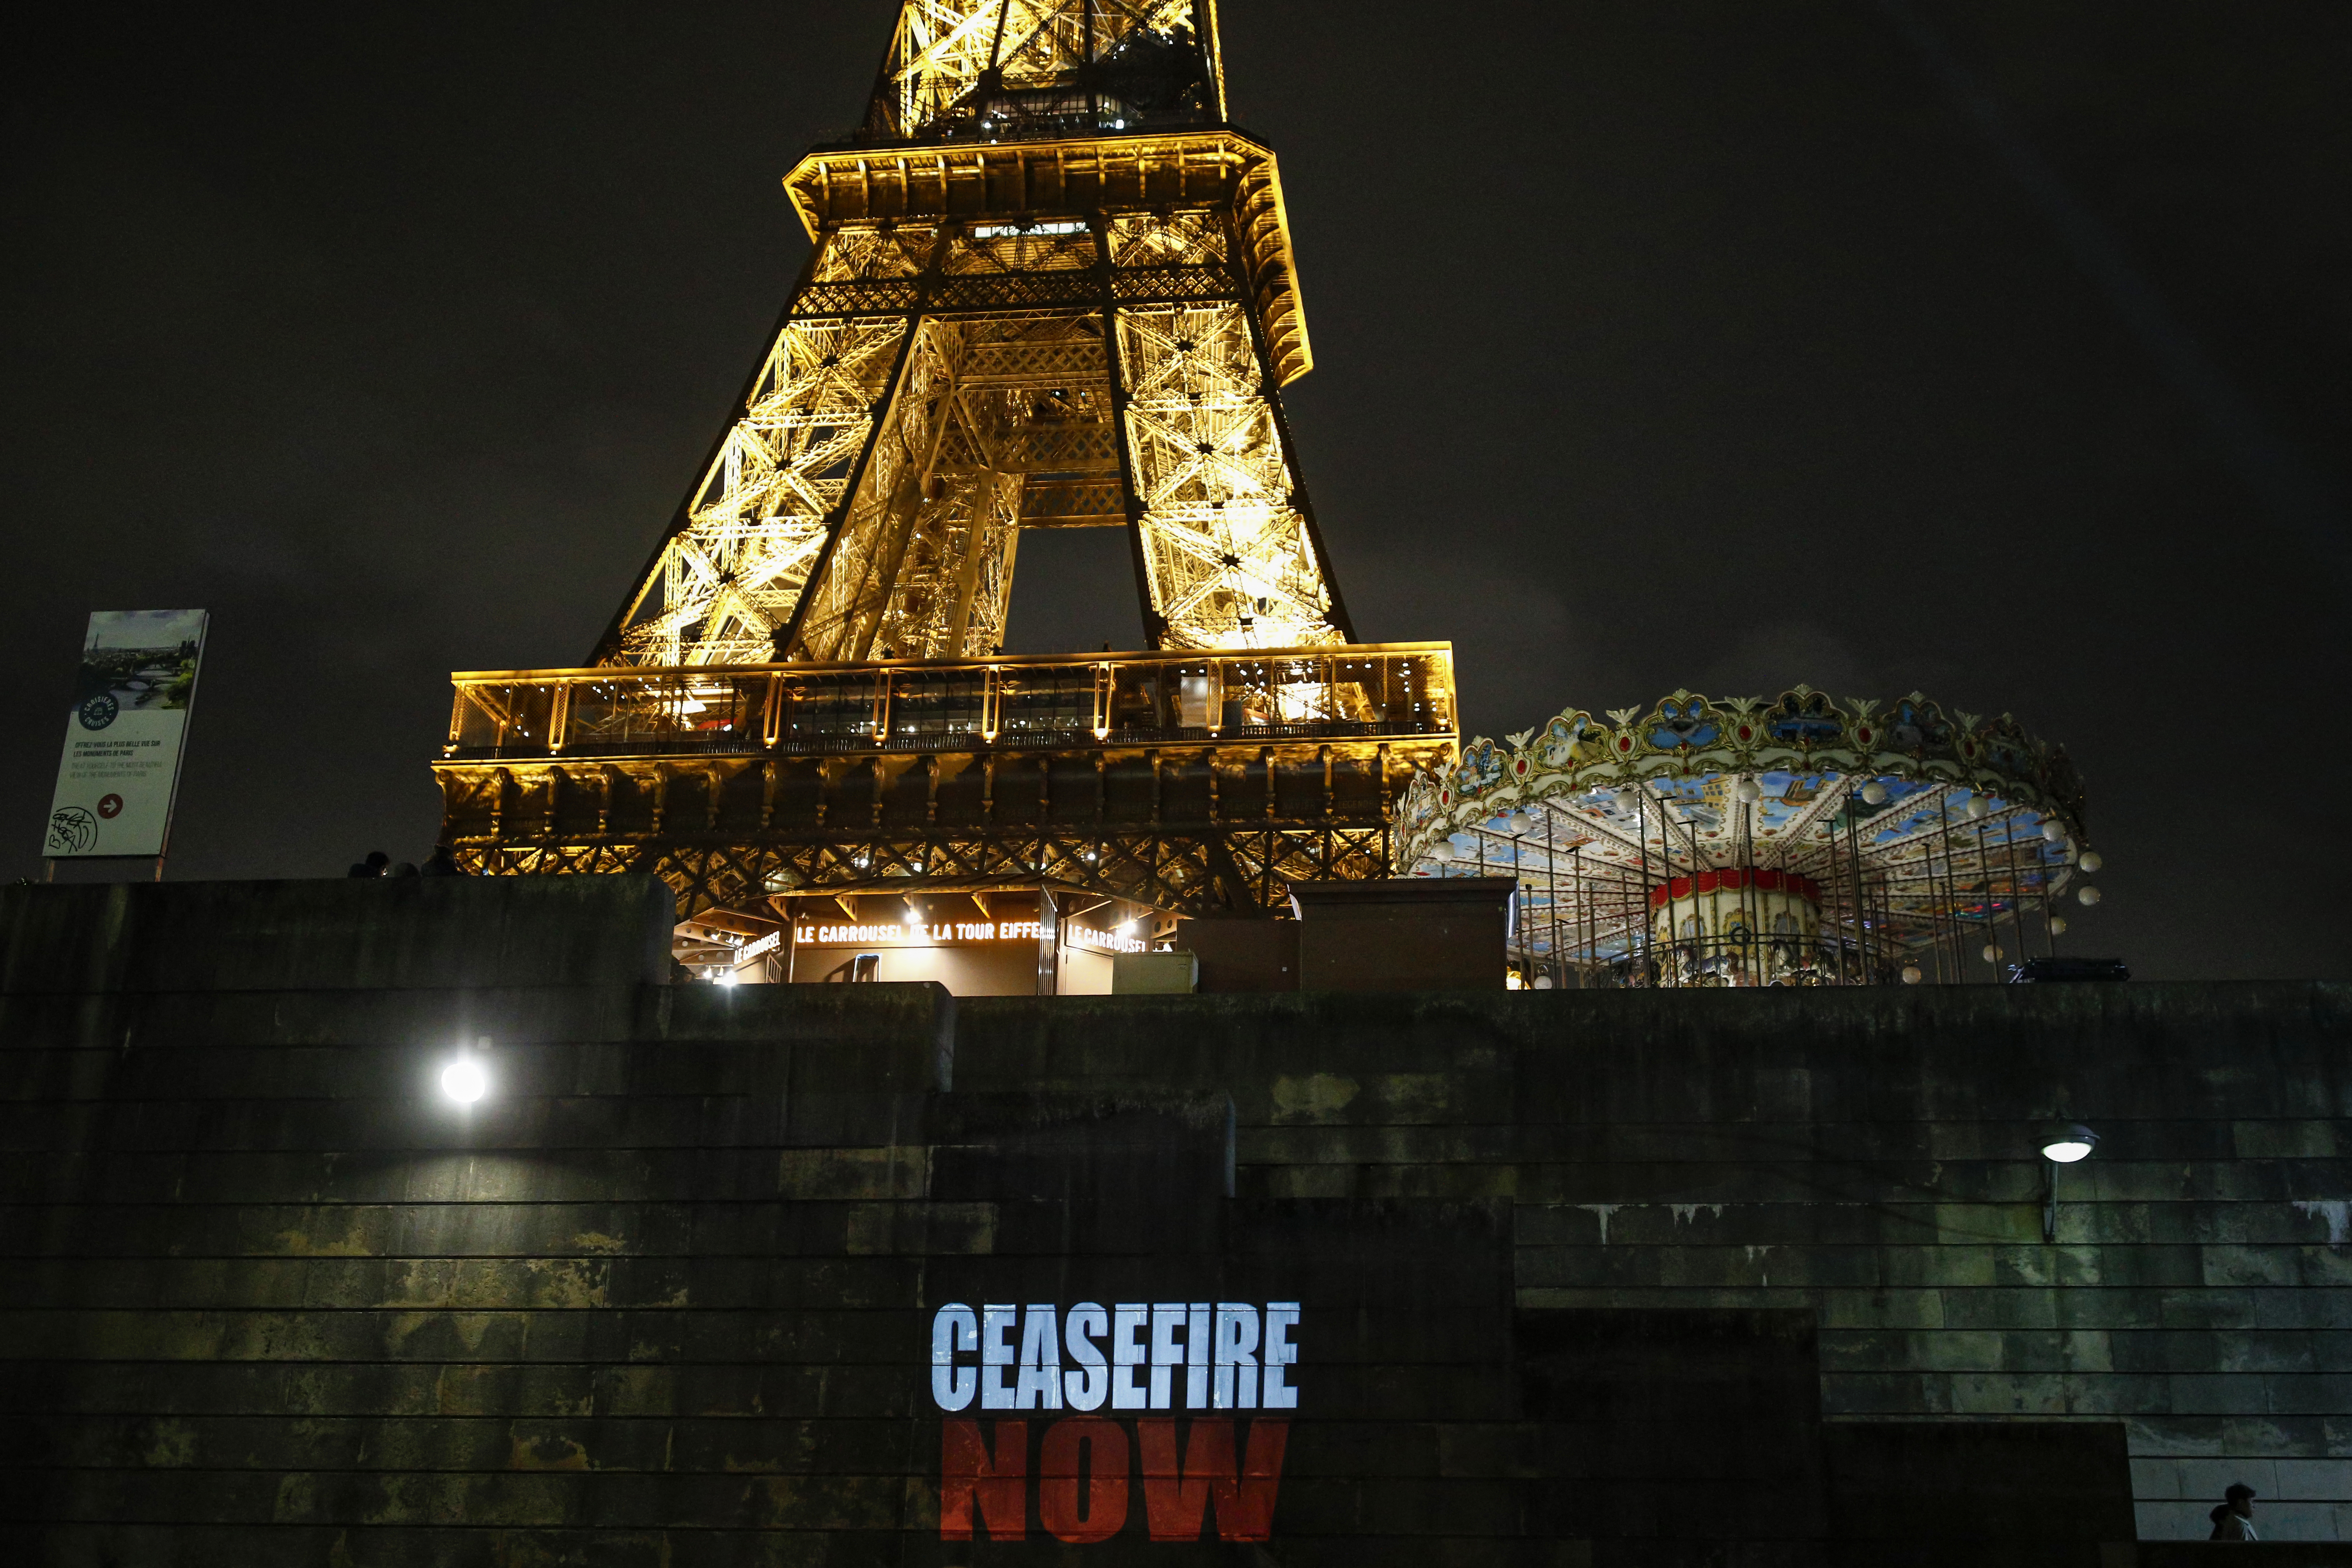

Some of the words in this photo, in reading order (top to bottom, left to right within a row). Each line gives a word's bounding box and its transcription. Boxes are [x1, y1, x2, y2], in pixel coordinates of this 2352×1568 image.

[85, 716, 109, 727] CRUISES
[797, 926, 815, 943] LE
[819, 925, 904, 942] CARROUSEL
[933, 924, 952, 940] LA
[956, 923, 994, 940] TOUR
[1000, 922, 1050, 939] EIFFE
[1068, 924, 1083, 944] LE
[931, 1302, 1300, 1412] CEASEFIRE
[940, 1415, 1289, 1543] NOW
